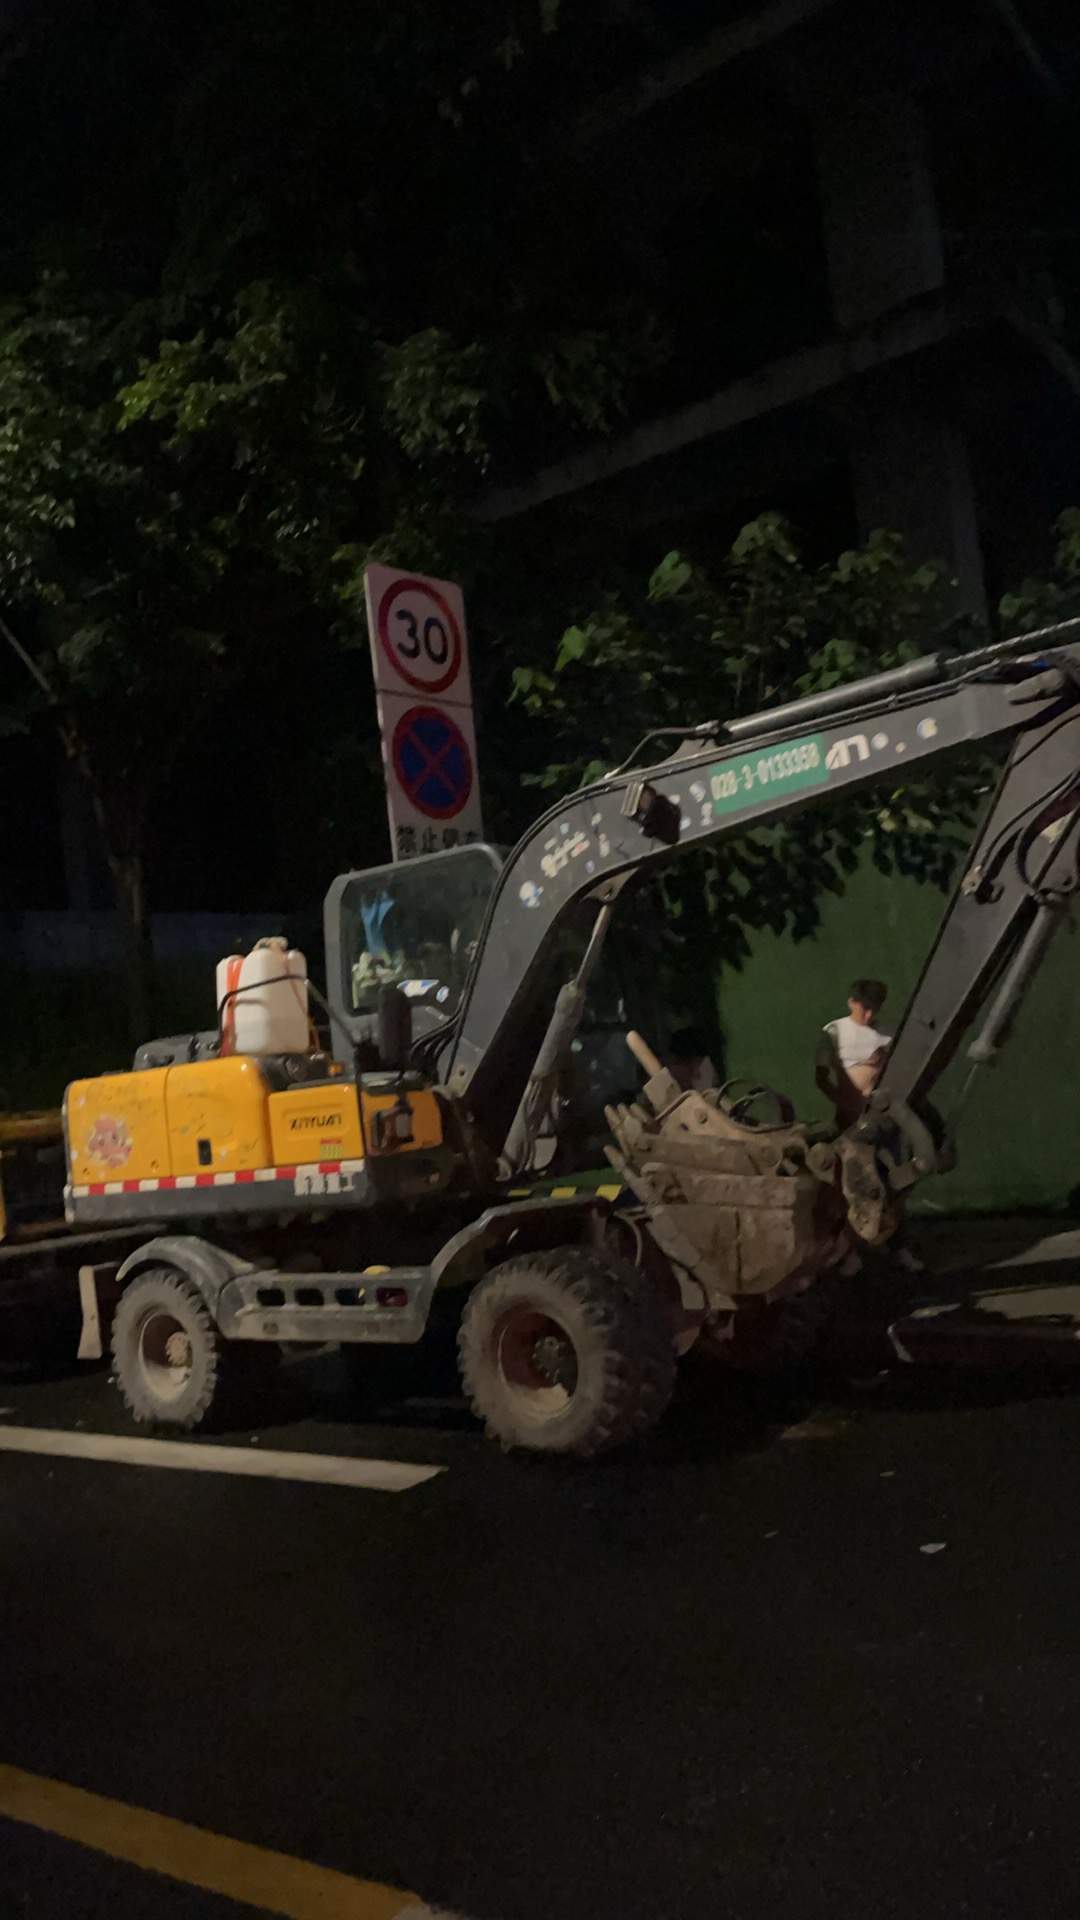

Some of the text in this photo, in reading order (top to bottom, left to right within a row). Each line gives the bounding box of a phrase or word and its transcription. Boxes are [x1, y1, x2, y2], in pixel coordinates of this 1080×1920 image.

[395, 608, 448, 664] 30
[396, 825, 478, 853] 禁止停
